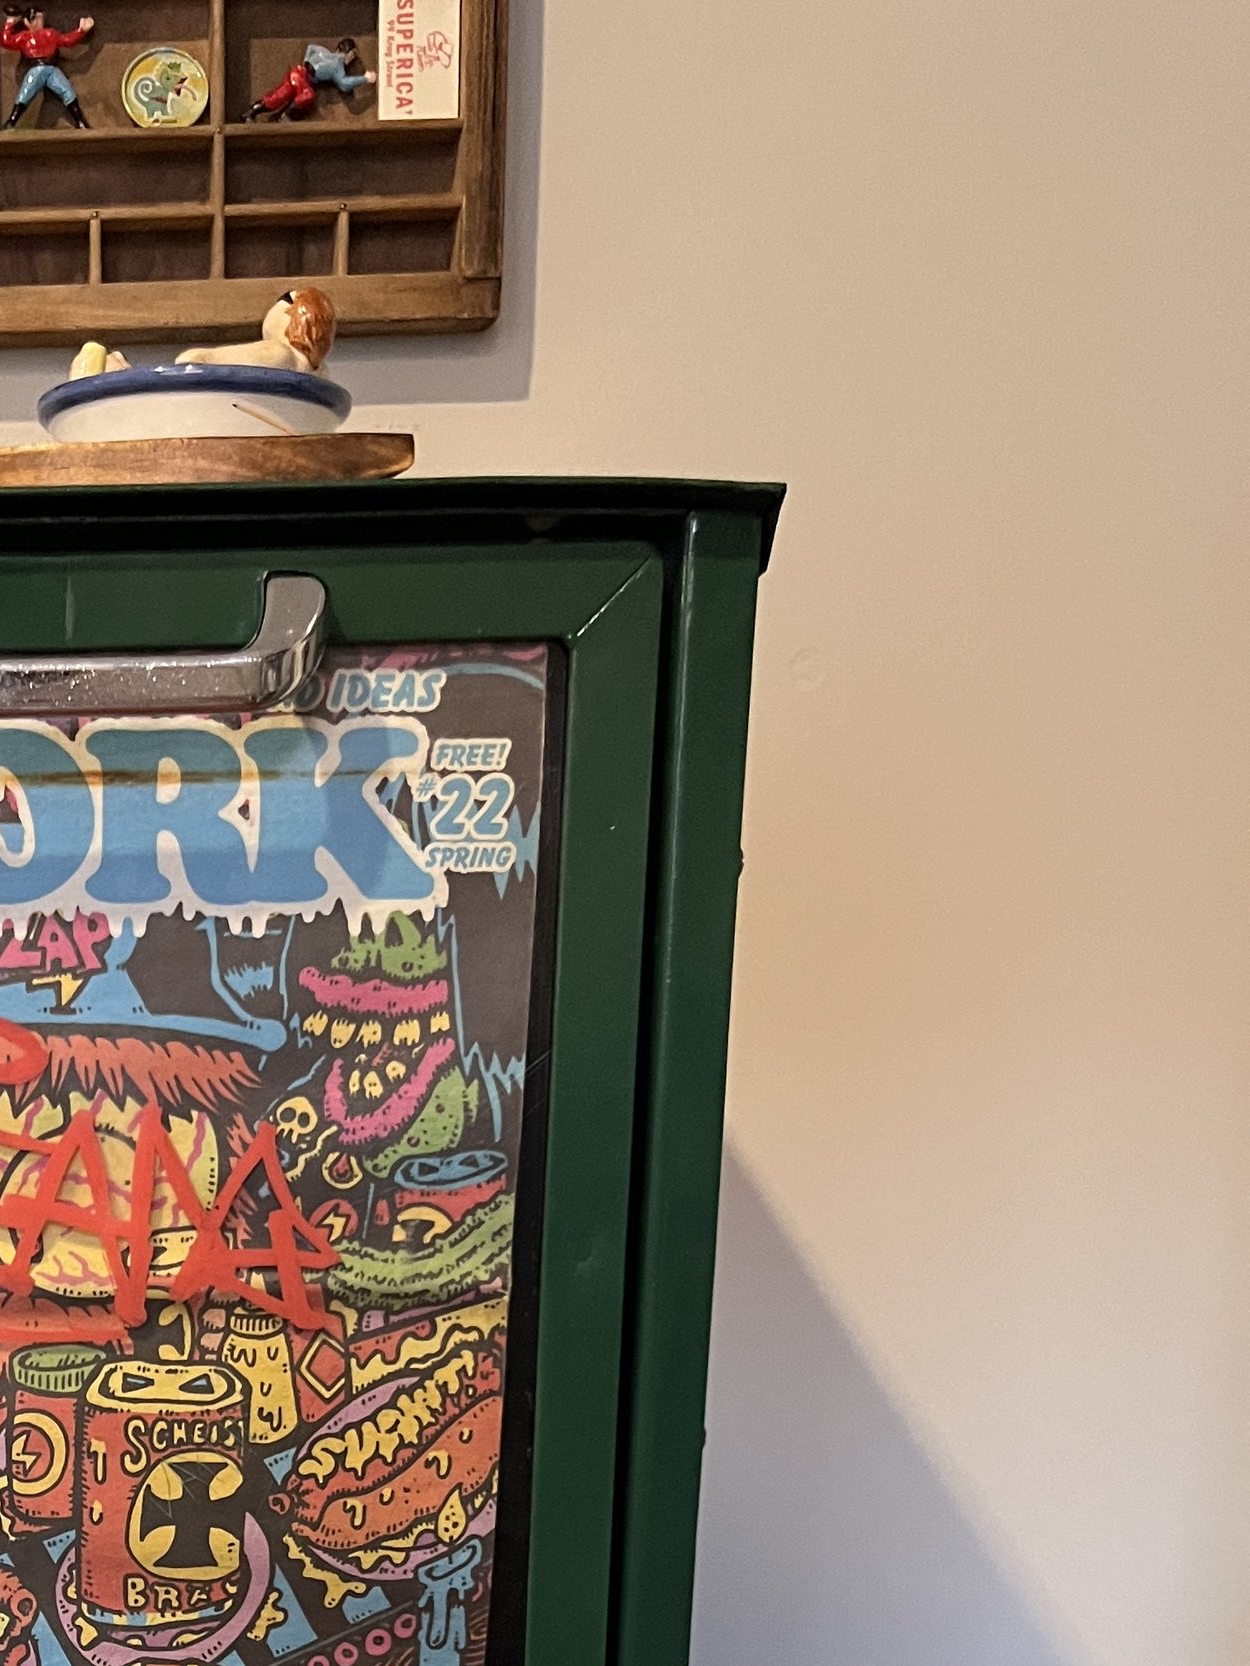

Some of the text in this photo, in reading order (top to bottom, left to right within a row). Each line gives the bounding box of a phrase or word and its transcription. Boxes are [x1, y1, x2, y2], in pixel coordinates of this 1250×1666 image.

[396, 0, 414, 109] SUPERICA
[329, 672, 442, 708] IDEAS
[435, 743, 508, 768] FREE!
[425, 846, 512, 869] SPRING
